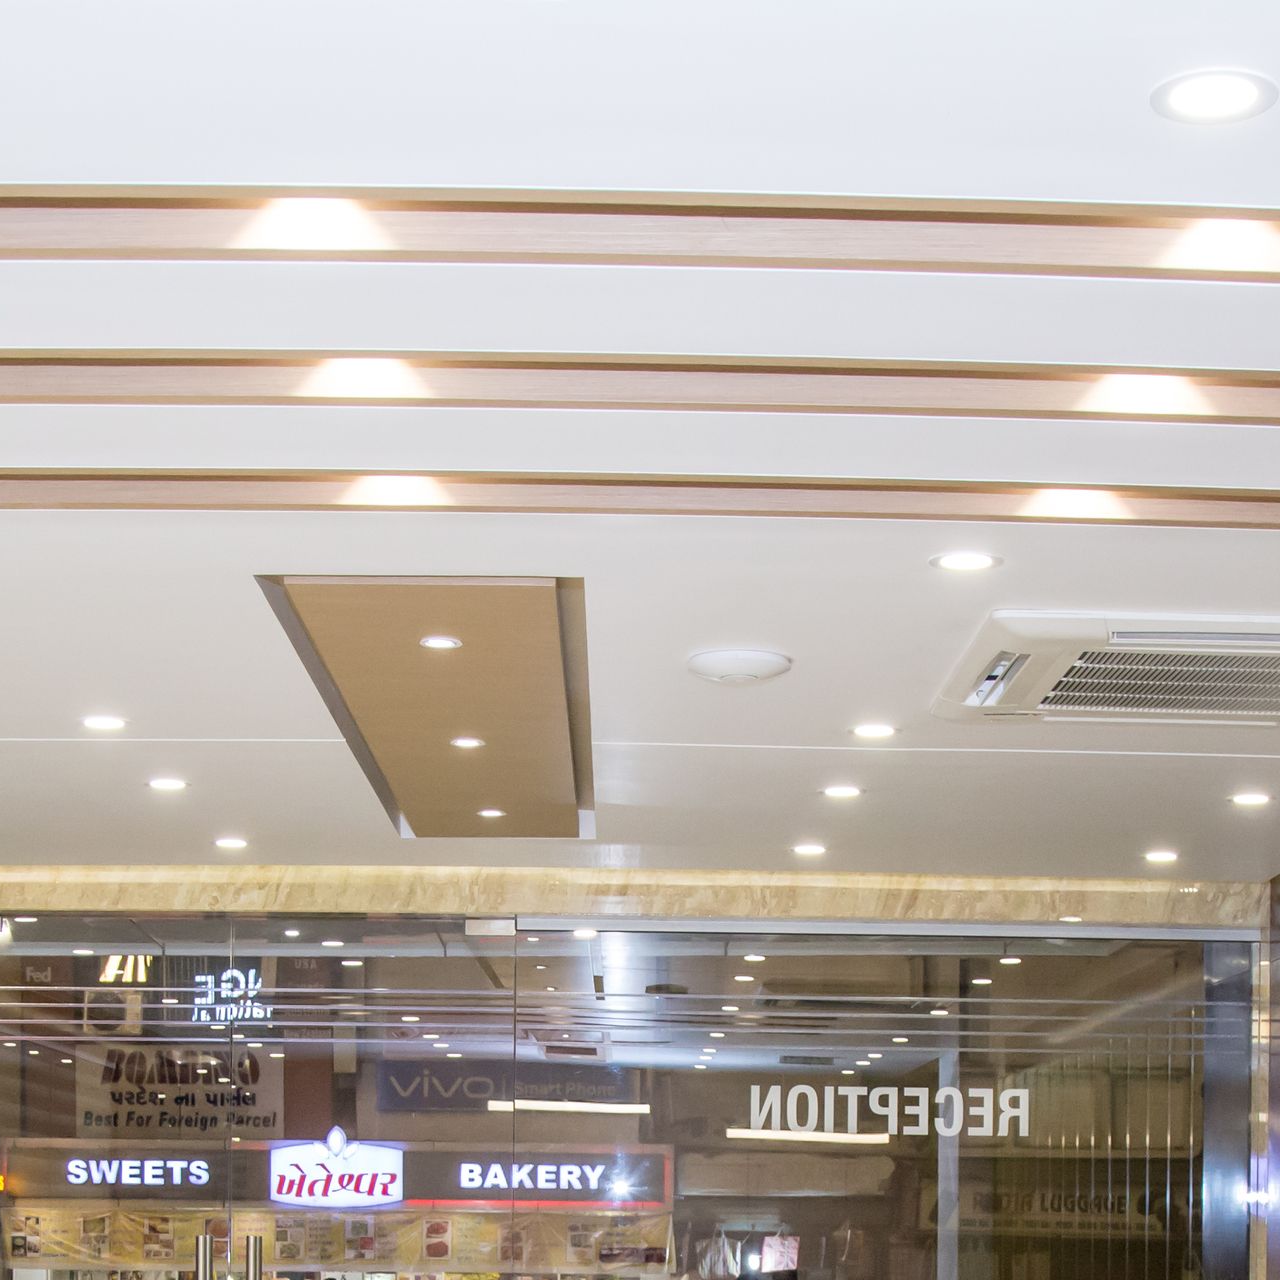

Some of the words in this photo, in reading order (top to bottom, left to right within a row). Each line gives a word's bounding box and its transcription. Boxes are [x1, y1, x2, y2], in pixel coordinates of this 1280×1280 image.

[389, 1068, 494, 1098] vivo
[83, 1111, 119, 1127] Best
[125, 1112, 152, 1127] For
[159, 1112, 218, 1131] Foreign
[226, 1112, 277, 1128] Parcel
[66, 1157, 210, 1187] SWEETS
[460, 1162, 606, 1191] BAKERY
